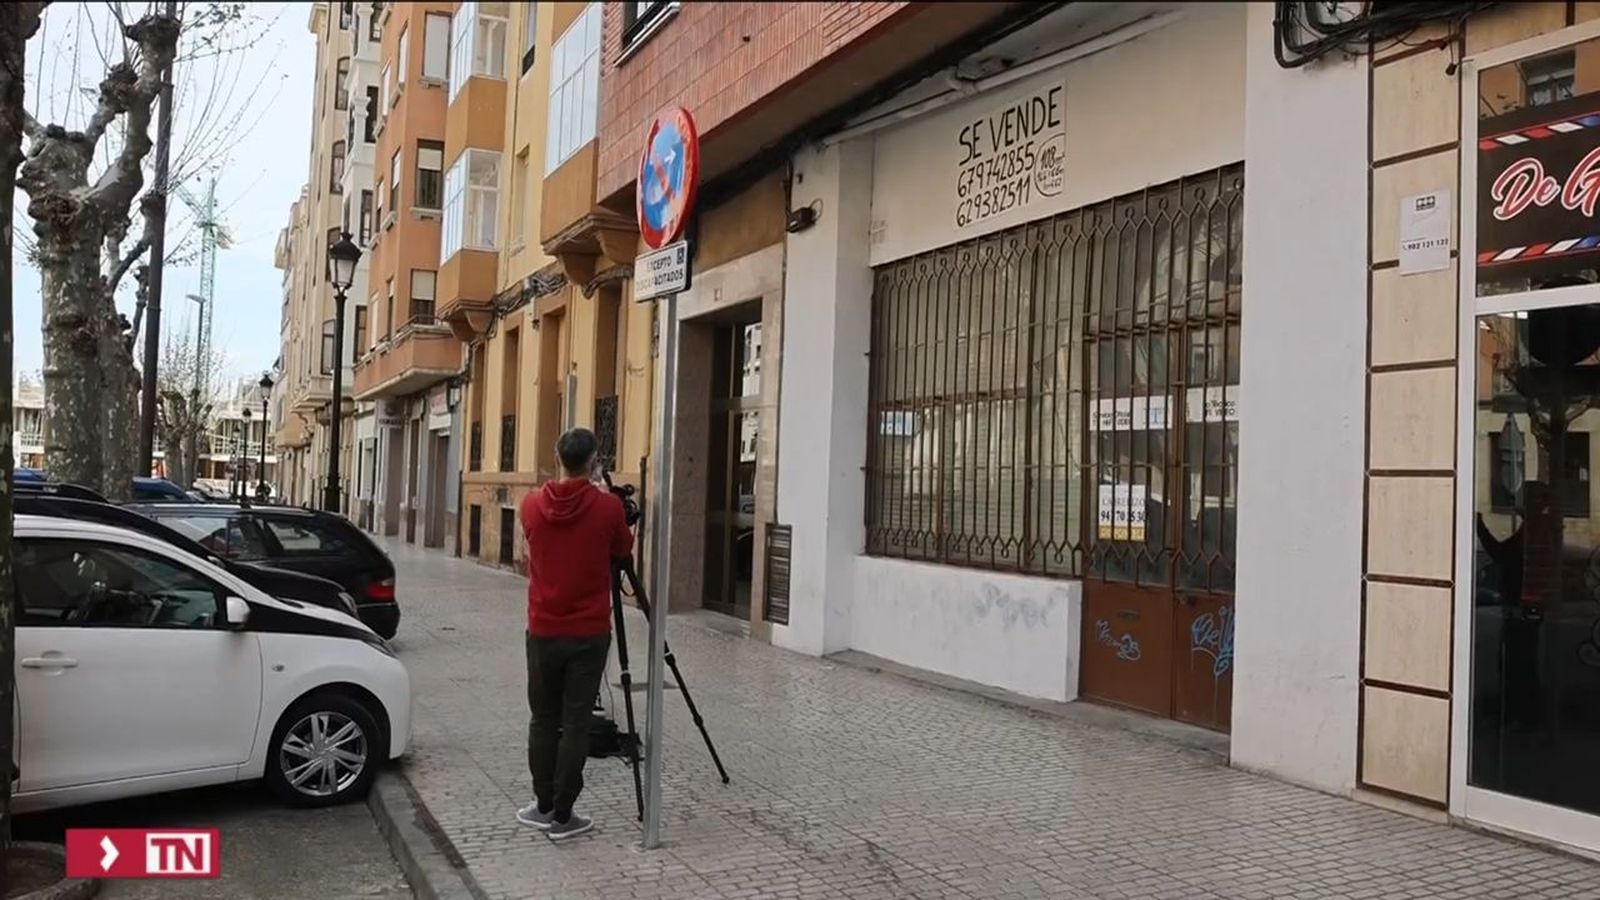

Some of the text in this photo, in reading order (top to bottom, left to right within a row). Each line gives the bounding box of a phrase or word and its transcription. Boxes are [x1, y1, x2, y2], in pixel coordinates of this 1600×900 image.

[958, 85, 1062, 166] SE VENDE
[957, 140, 1035, 198] 679742855
[1491, 157, 1561, 221] De
[956, 174, 1031, 228] 629382511
